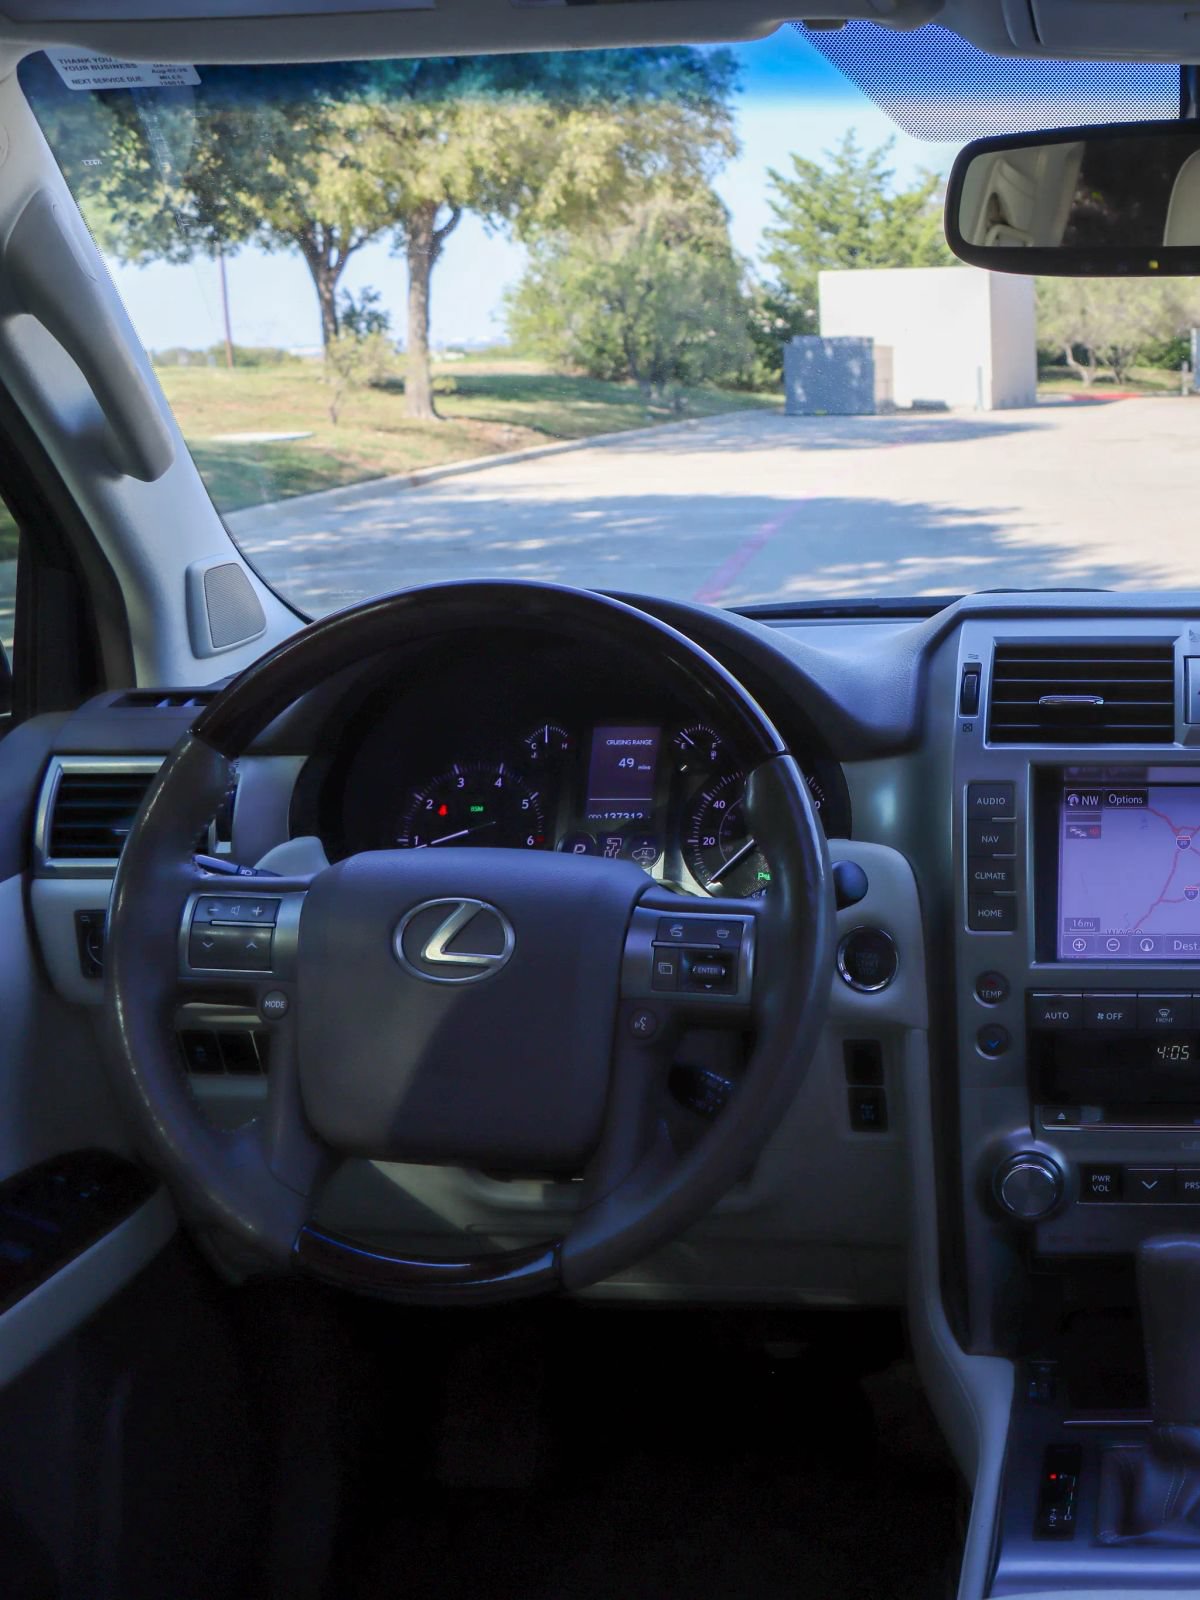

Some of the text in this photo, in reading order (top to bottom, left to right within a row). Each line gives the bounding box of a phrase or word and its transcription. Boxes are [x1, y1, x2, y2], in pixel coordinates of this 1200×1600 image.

[57, 57, 91, 65] THANK
[90, 63, 138, 71] BUSINESS
[618, 757, 634, 768] 49
[457, 777, 465, 788] 3
[494, 777, 502, 788] 4
[713, 800, 726, 808] 40
[976, 797, 1006, 805] AUDIO
[1081, 795, 1099, 805] NW
[1108, 793, 1143, 806] Options
[425, 799, 433, 810] 2
[521, 799, 529, 810] 5
[414, 835, 419, 845] 1
[526, 835, 534, 846] 6
[703, 837, 715, 846] 20
[981, 836, 1000, 844] NAV
[974, 872, 1006, 880] CLIMATE
[977, 909, 1003, 917] HOME
[1173, 940, 1200, 951] Dest.
[981, 990, 1003, 998] TEMP
[264, 1000, 285, 1009] MODE
[1044, 1012, 1070, 1020] AUTO
[1106, 1012, 1123, 1020] OFF
[1157, 1045, 1190, 1060] 4:05
[1091, 1184, 1110, 1192] VOL
